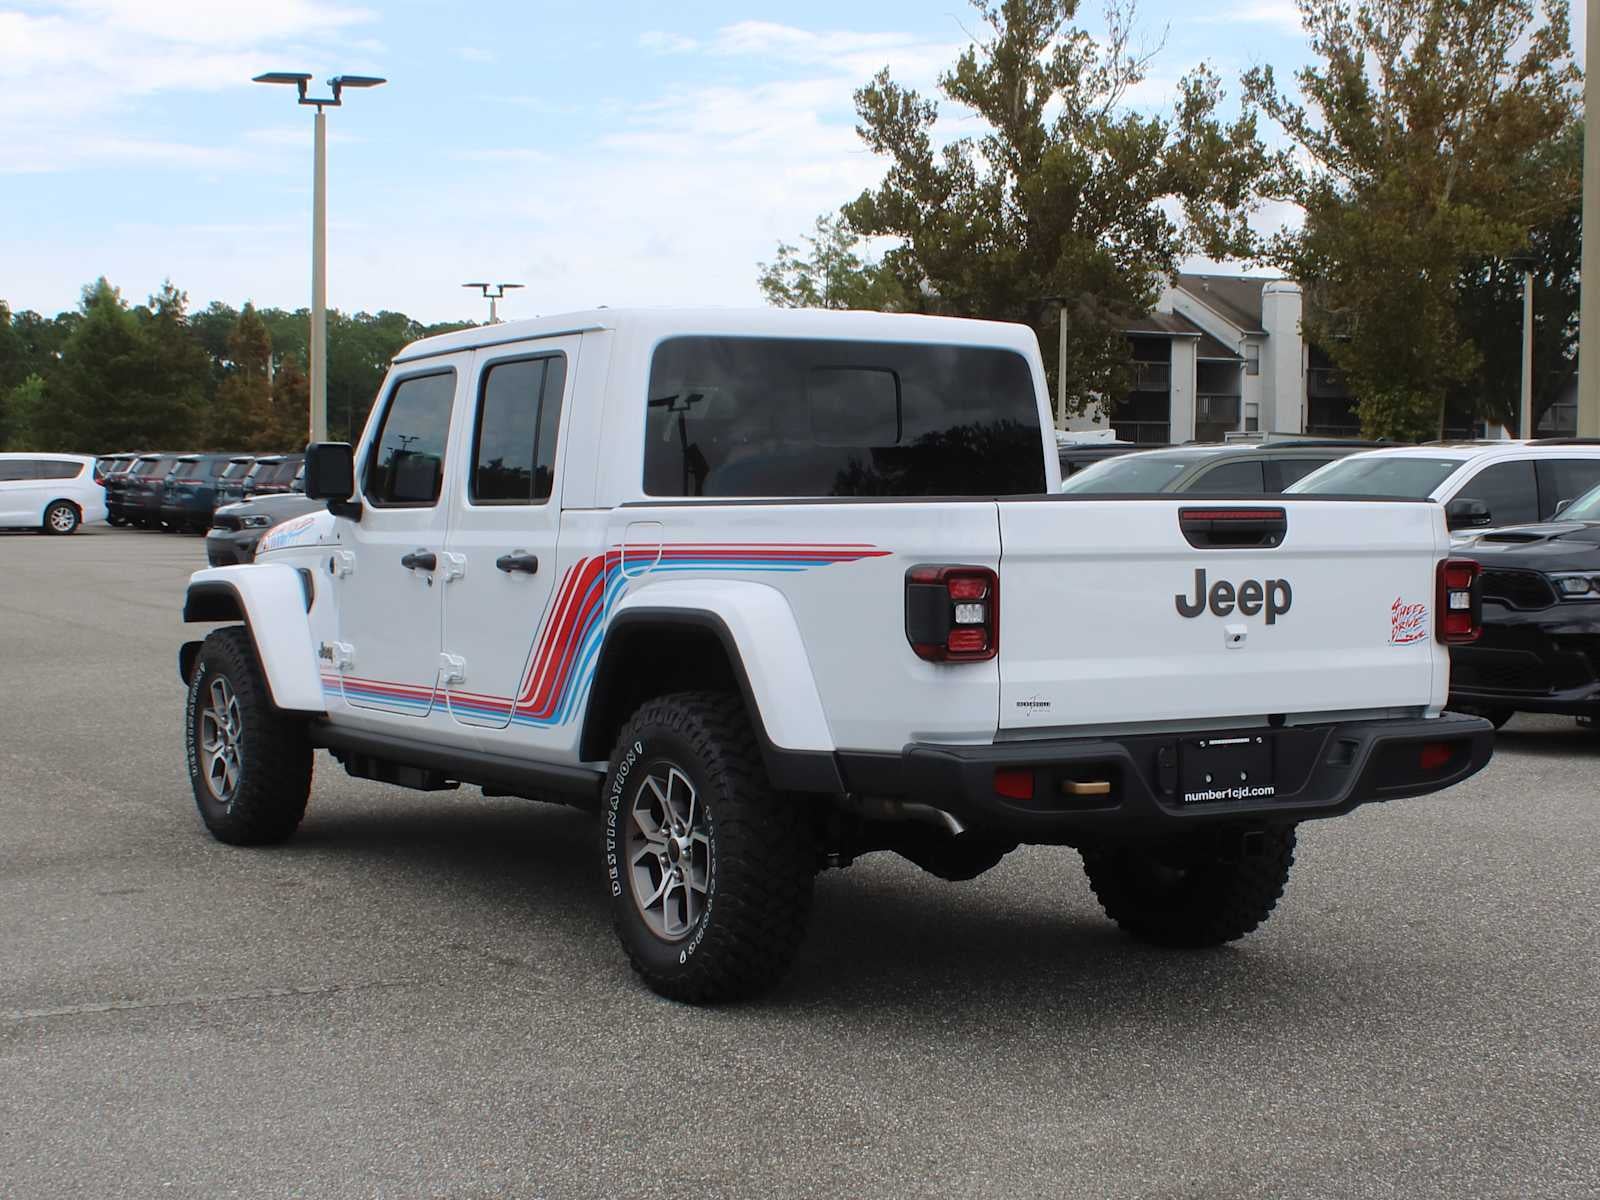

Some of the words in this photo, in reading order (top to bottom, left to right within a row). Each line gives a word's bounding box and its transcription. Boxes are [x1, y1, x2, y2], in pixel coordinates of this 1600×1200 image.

[1175, 568, 1292, 625] Jeep
[1184, 786, 1275, 802] number1cjd.com
[606, 751, 637, 896] DESTINATION
